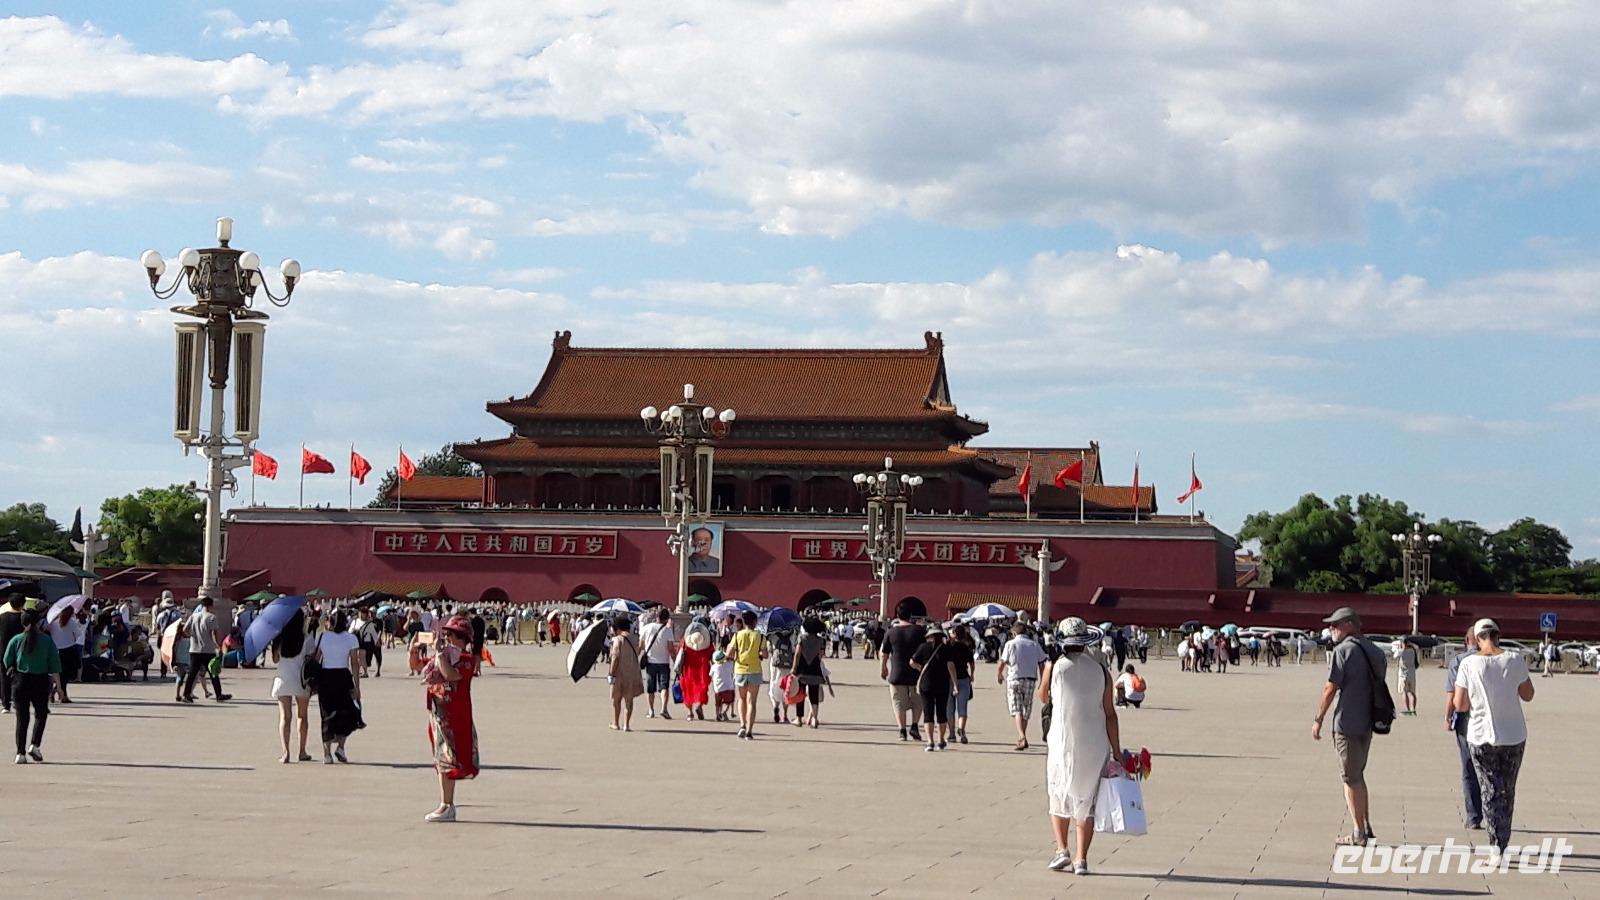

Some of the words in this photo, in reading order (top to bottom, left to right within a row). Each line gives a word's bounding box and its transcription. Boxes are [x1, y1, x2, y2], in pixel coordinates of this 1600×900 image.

[385, 533, 603, 553] 中华人民共和国万岁
[804, 540, 1034, 561] 世界人大团结万岁
